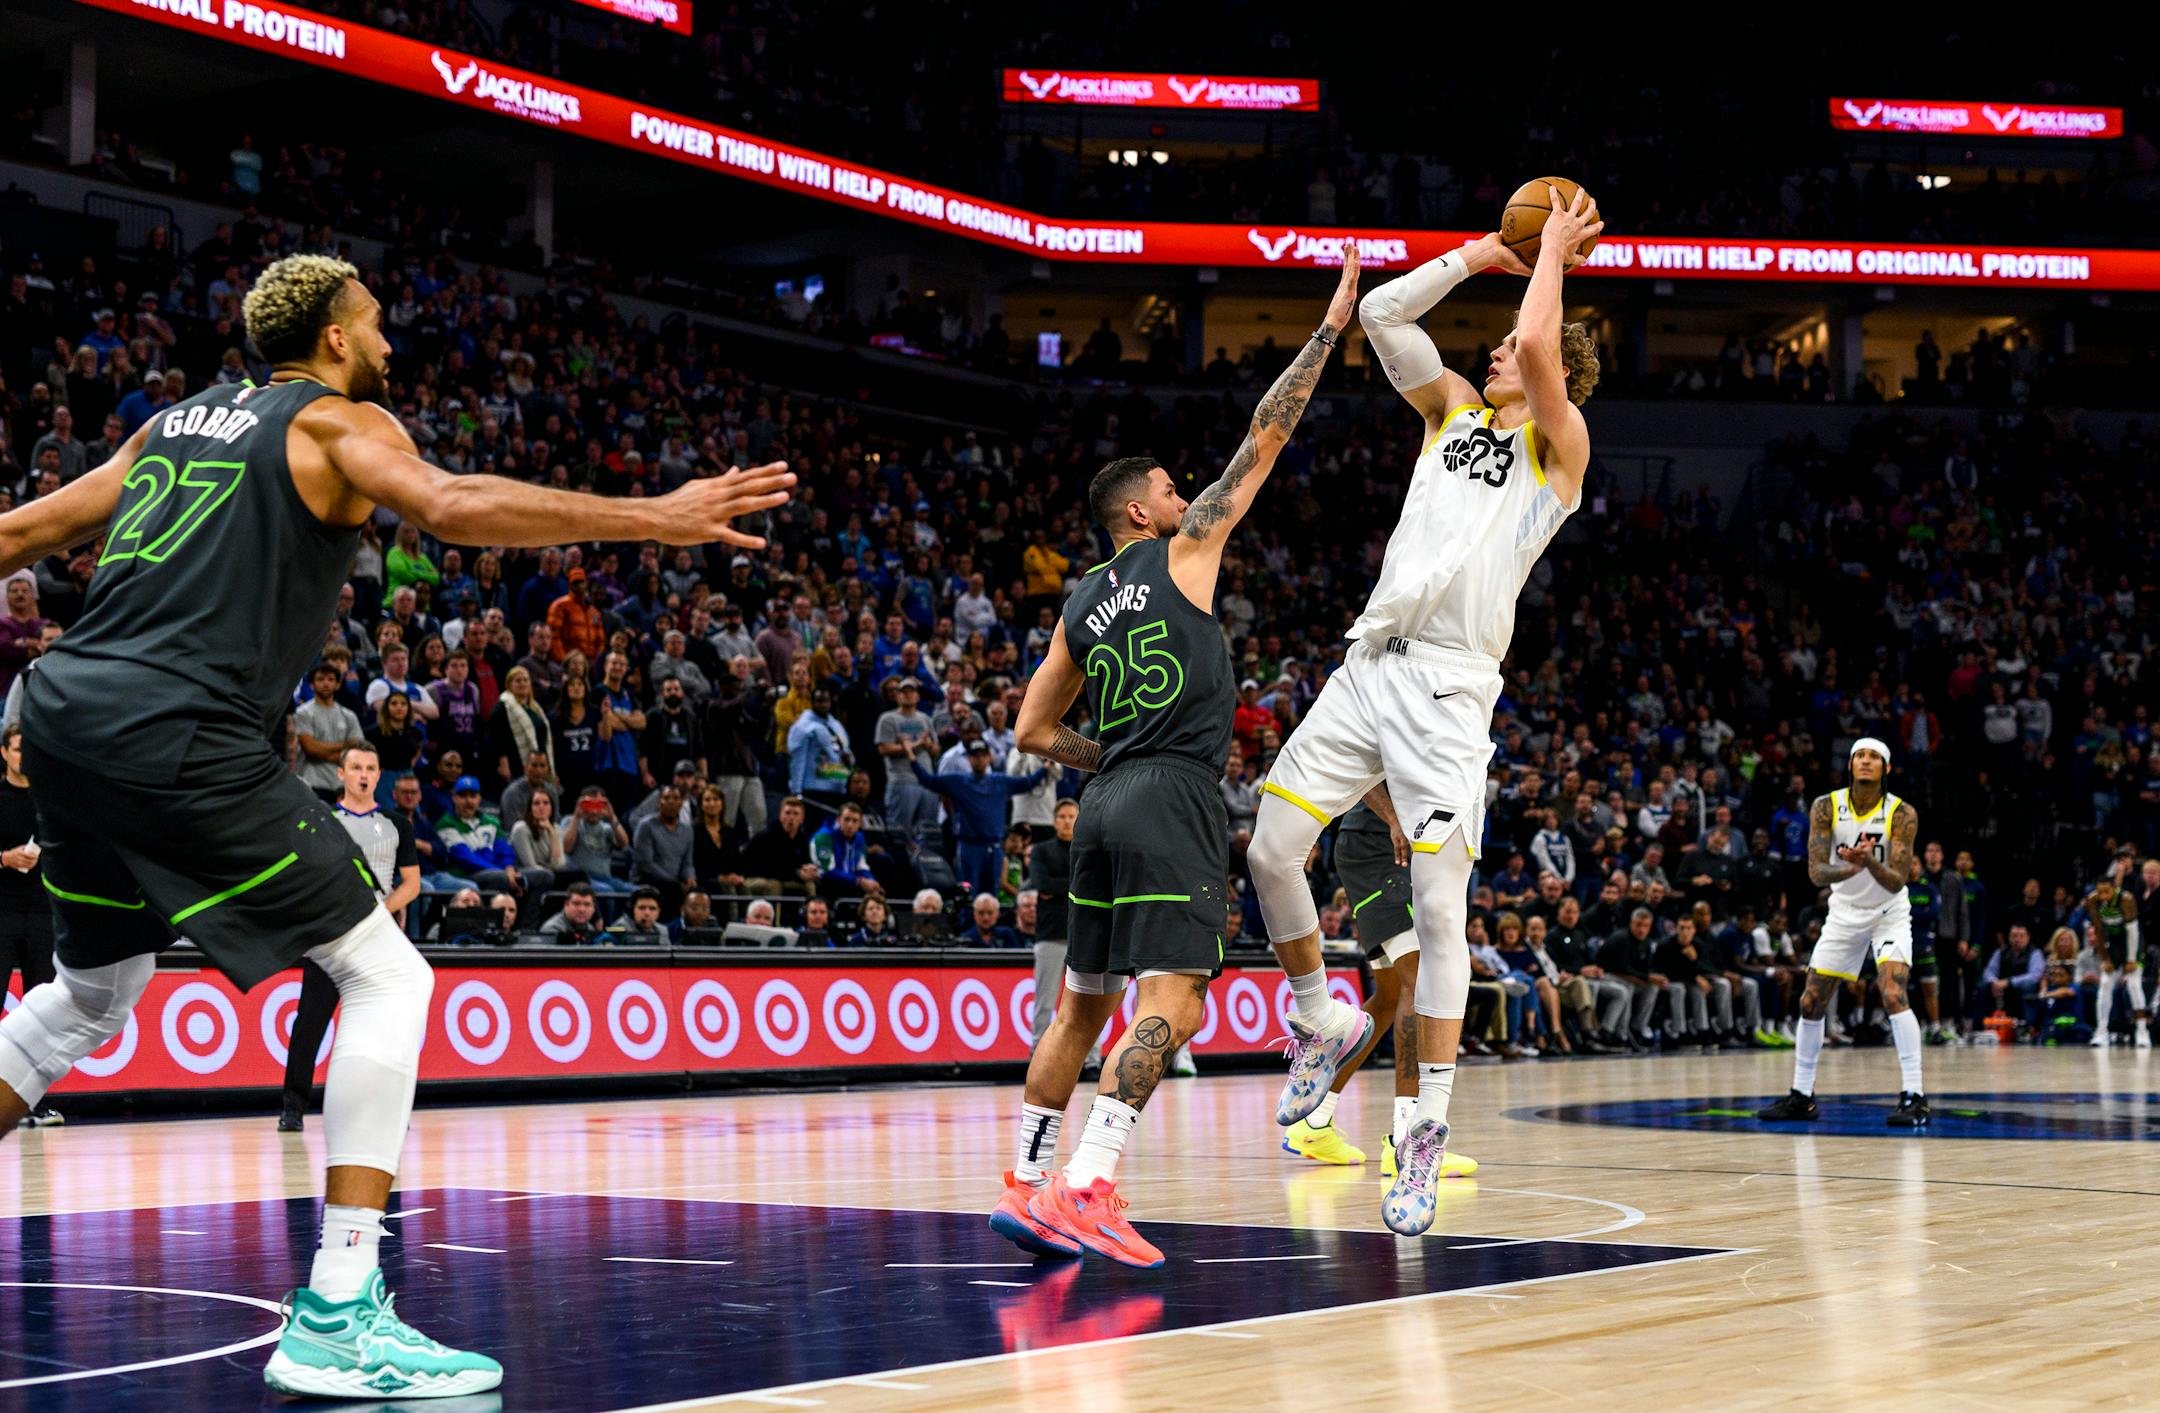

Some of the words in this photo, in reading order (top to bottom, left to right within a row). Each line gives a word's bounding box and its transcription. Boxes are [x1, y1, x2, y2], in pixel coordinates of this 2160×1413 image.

[223, 0, 346, 59] PROTEIN
[474, 69, 523, 107] JACK
[630, 111, 714, 159] POWER
[716, 135, 775, 174] THRU
[777, 151, 831, 189] WITH
[833, 168, 886, 202] HELP
[888, 183, 945, 219] FROM
[945, 199, 1034, 244] ORIGINAL
[1035, 224, 1144, 253] PROTEIN
[1637, 244, 1703, 269] WITH
[1708, 246, 1775, 271] HELP
[1778, 247, 1853, 273] FROM
[1857, 249, 1979, 277] ORIGINAL
[1982, 254, 2090, 279] PROTEIN
[1468, 438, 1515, 488] 23
[97, 455, 246, 566] 27
[1386, 636, 1410, 656] UTAH
[1086, 620, 1184, 732] 25
